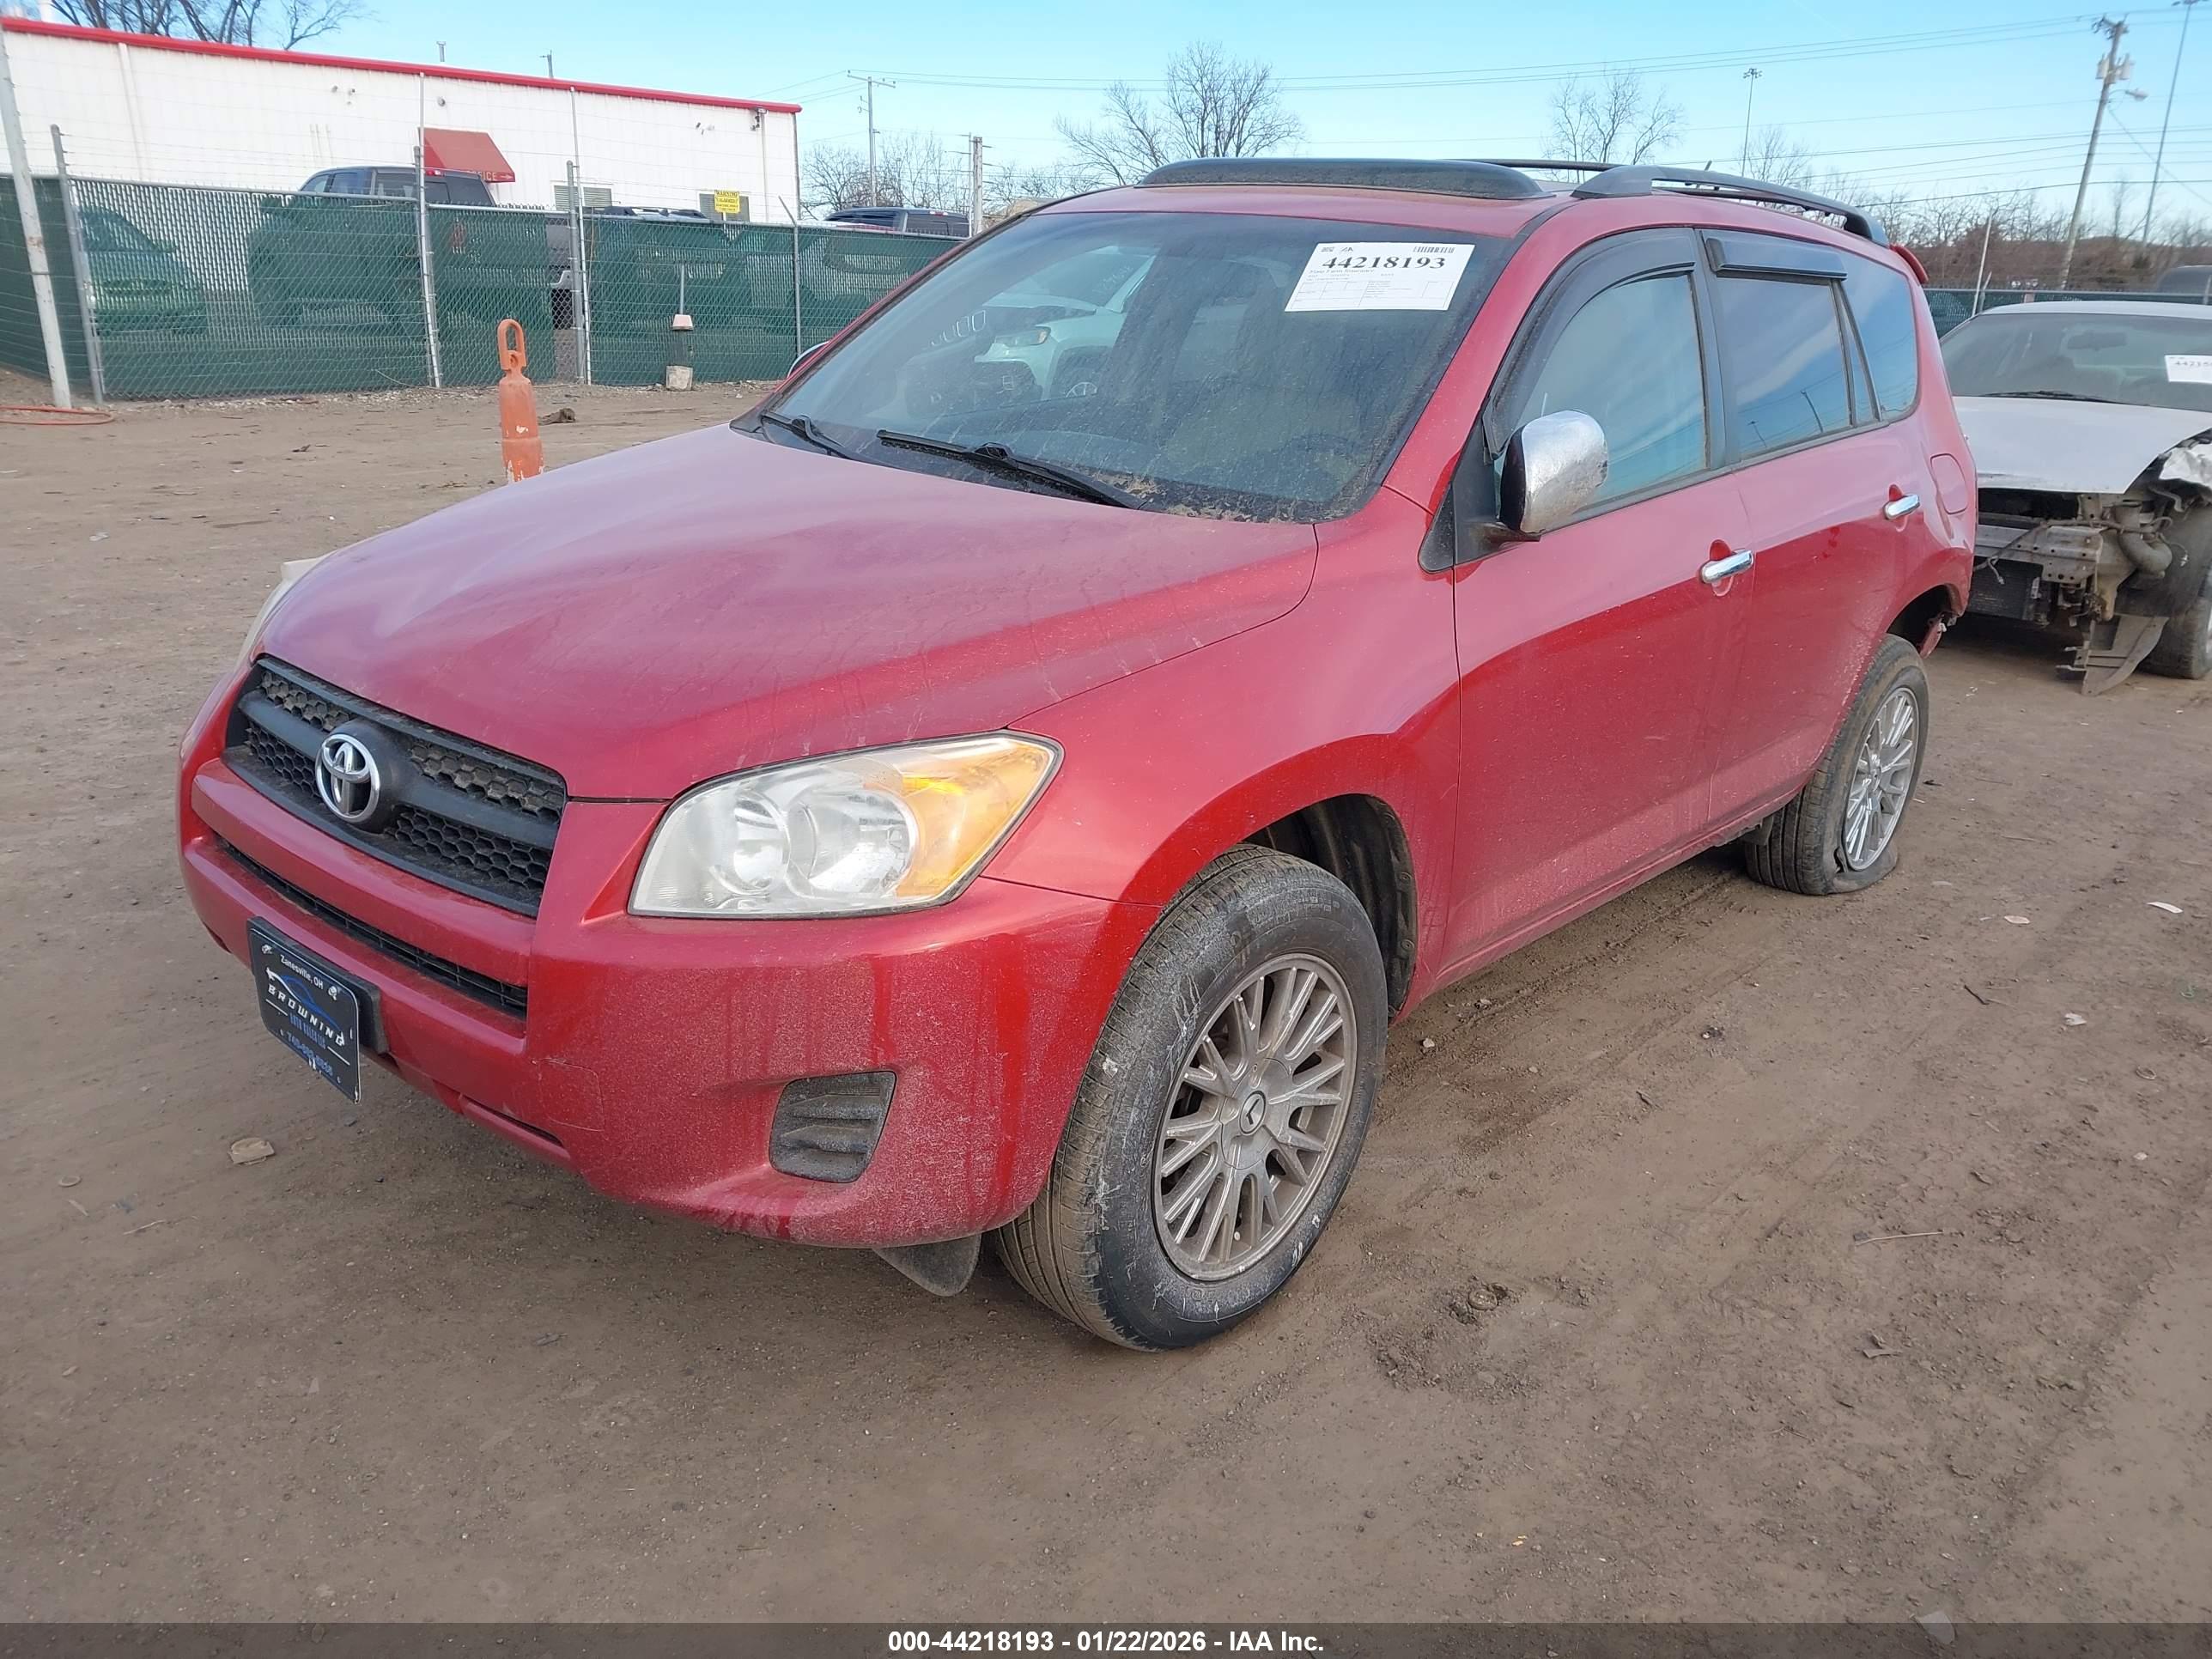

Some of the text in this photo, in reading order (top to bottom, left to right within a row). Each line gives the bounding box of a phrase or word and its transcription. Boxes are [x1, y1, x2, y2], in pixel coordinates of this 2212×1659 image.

[1321, 256, 1446, 269] 44218193
[280, 954, 323, 989] Zanesville, OH
[268, 983, 345, 1047] BROWNING
